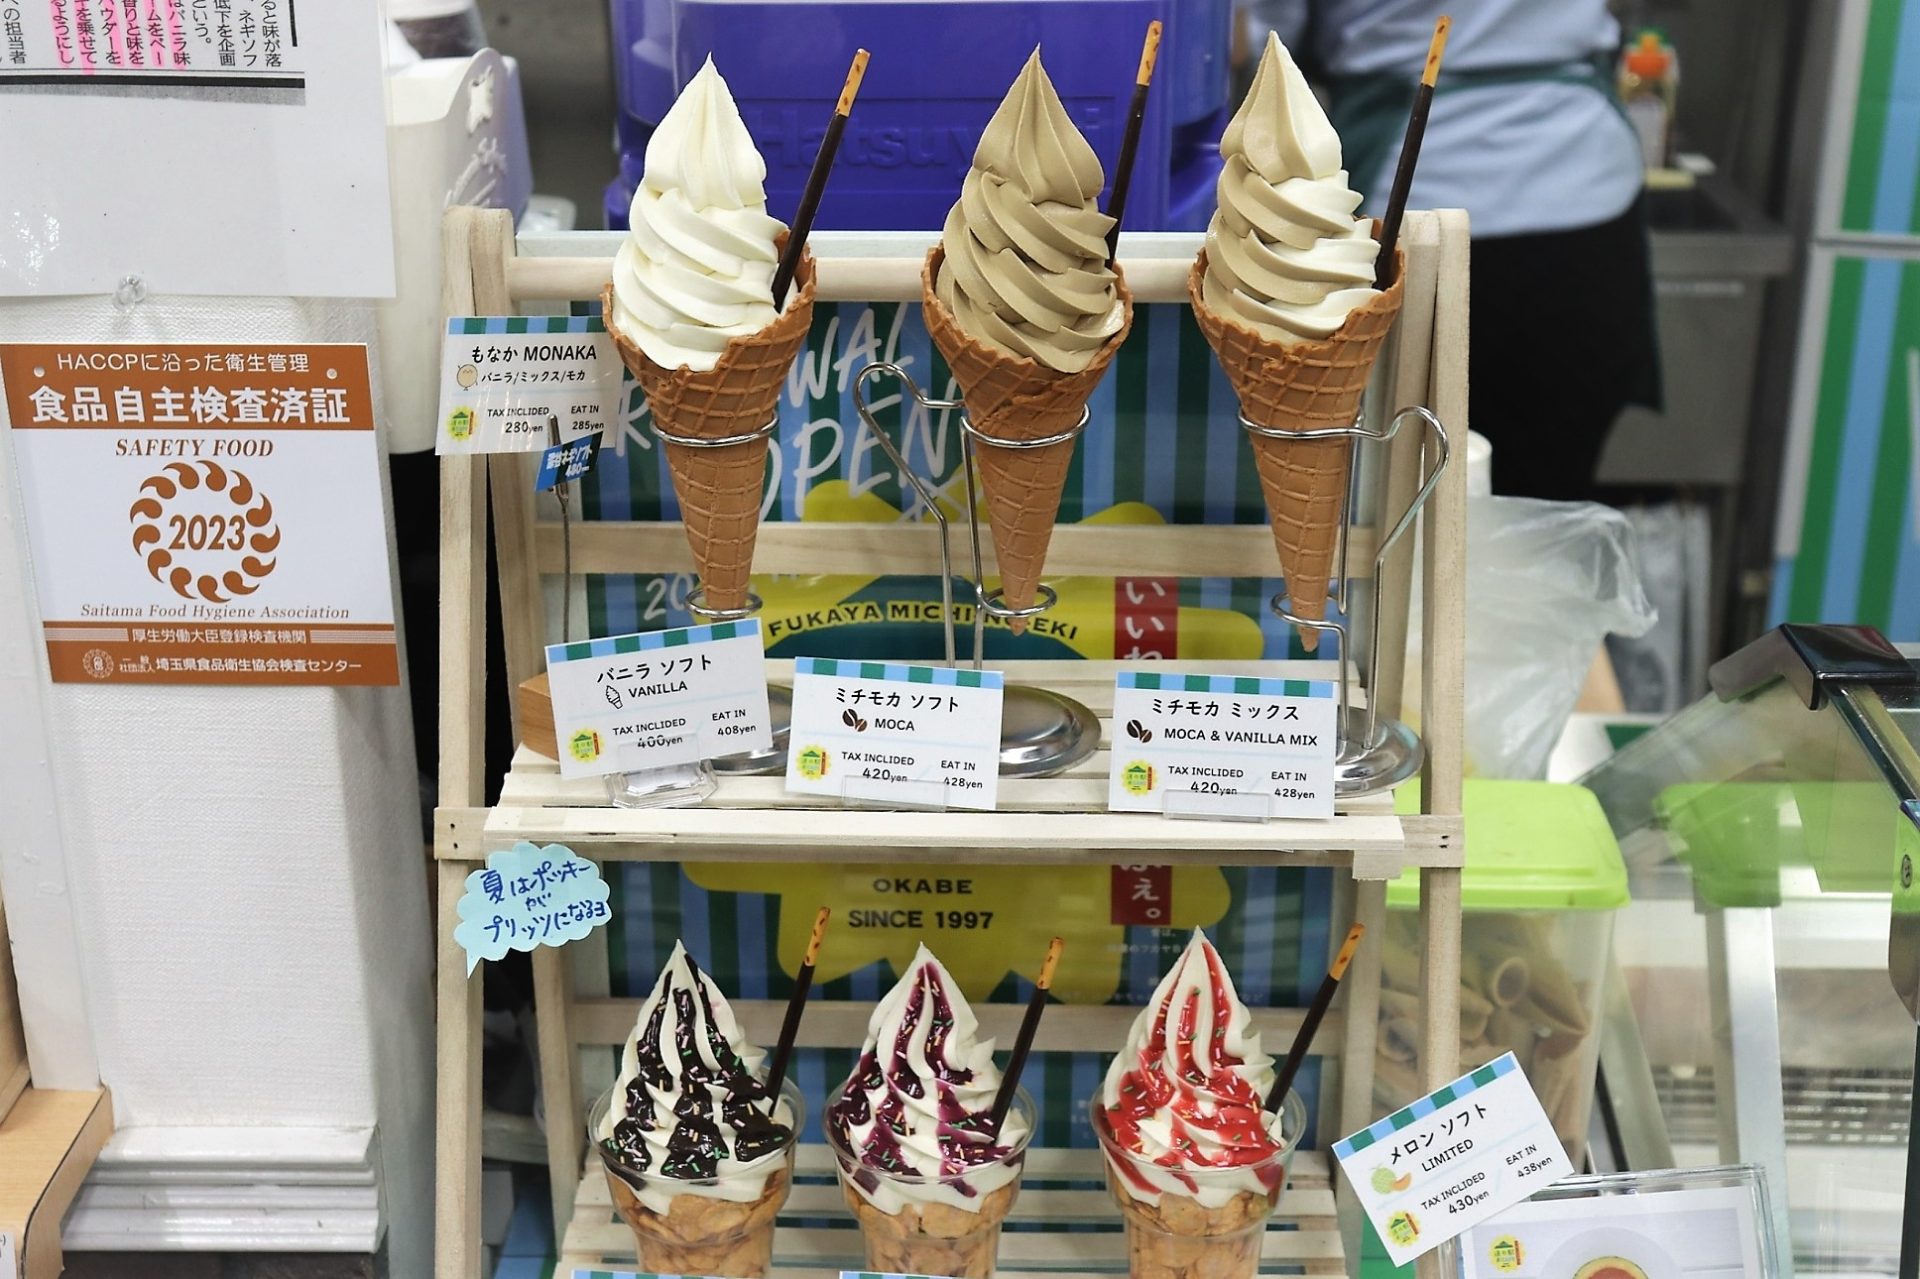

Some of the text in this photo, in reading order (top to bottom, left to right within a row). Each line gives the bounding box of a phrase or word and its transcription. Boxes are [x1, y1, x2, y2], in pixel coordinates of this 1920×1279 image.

[471, 345, 597, 363] もなか MONAKA
[57, 353, 310, 373] HACCPに沿った衛生管理
[28, 385, 350, 424] 食品自主検査済証
[487, 409, 504, 417] TAX
[571, 405, 599, 414] EAT IN
[572, 421, 604, 432] 285yen
[115, 438, 274, 457] SAFETY FOOD
[168, 514, 245, 551] 2023
[80, 603, 350, 621] Saitama Food Hygiene Association
[768, 604, 880, 637] FUKAYA
[597, 654, 712, 683] バニラ ソフト
[628, 681, 688, 698] VANILLA
[836, 687, 959, 713] ミチモカ ソフト
[712, 709, 747, 721] EAT IN
[1152, 698, 1299, 720] ミチモカ ミックス
[612, 725, 634, 736] TAX
[717, 724, 756, 737] 408yen
[874, 718, 915, 731] MOCA
[1164, 728, 1318, 746] MOCA & VANILLA MIX
[841, 751, 862, 762] TAX
[940, 760, 976, 771] EAT IN
[1168, 766, 1189, 776] TAX
[862, 767, 908, 783] 420yen
[943, 776, 983, 790] 428yen
[1271, 771, 1307, 781] EAT IN
[1190, 781, 1238, 796] 420yen
[1274, 787, 1315, 800] 428yen
[873, 878, 973, 894] OKABE
[848, 909, 994, 930] SINCE 1997
[1391, 1103, 1487, 1164] メロン ソフト
[1421, 1138, 1474, 1172] LIMITED
[1505, 1144, 1537, 1166] EAT IN
[1517, 1156, 1553, 1178] 438yen
[1421, 1197, 1441, 1210] TAX
[1449, 1190, 1490, 1214] 430yen
